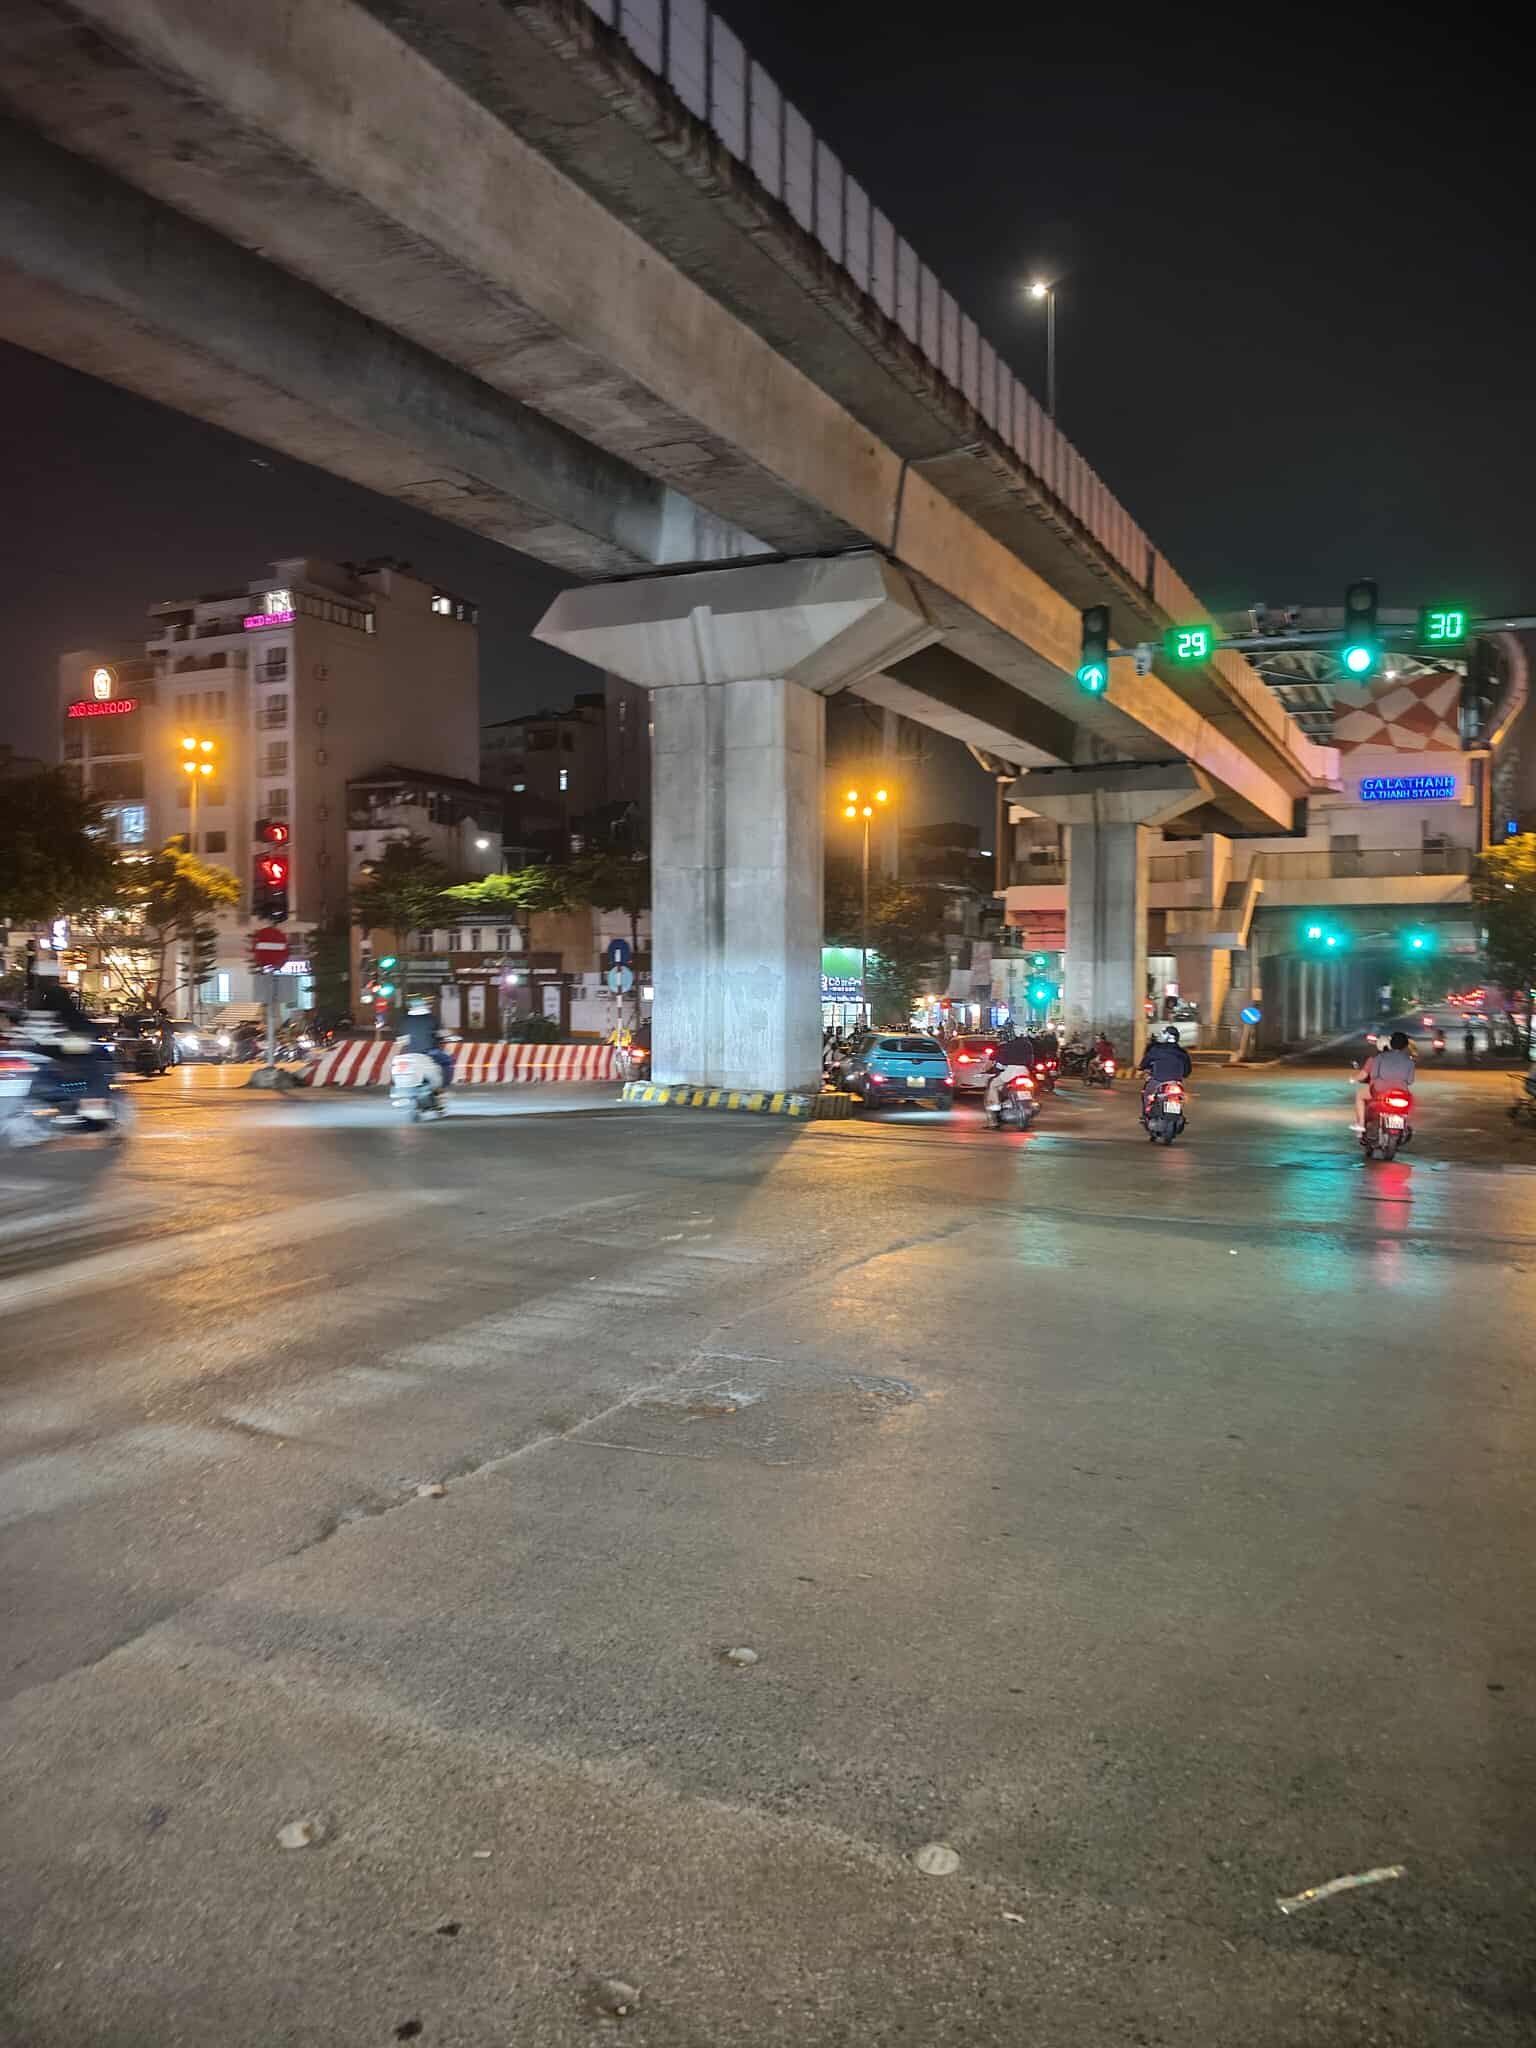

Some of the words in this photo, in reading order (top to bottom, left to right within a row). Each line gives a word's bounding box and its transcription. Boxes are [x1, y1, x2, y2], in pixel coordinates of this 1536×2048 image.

[1430, 613, 1461, 639] 30
[1178, 632, 1206, 658] 29
[87, 701, 132, 714] SEAFOOD
[1364, 779, 1383, 790] GA
[1387, 778, 1403, 789] LA
[1363, 791, 1376, 799] LA
[1379, 789, 1409, 799] THANH
[1412, 788, 1453, 798] STATION
